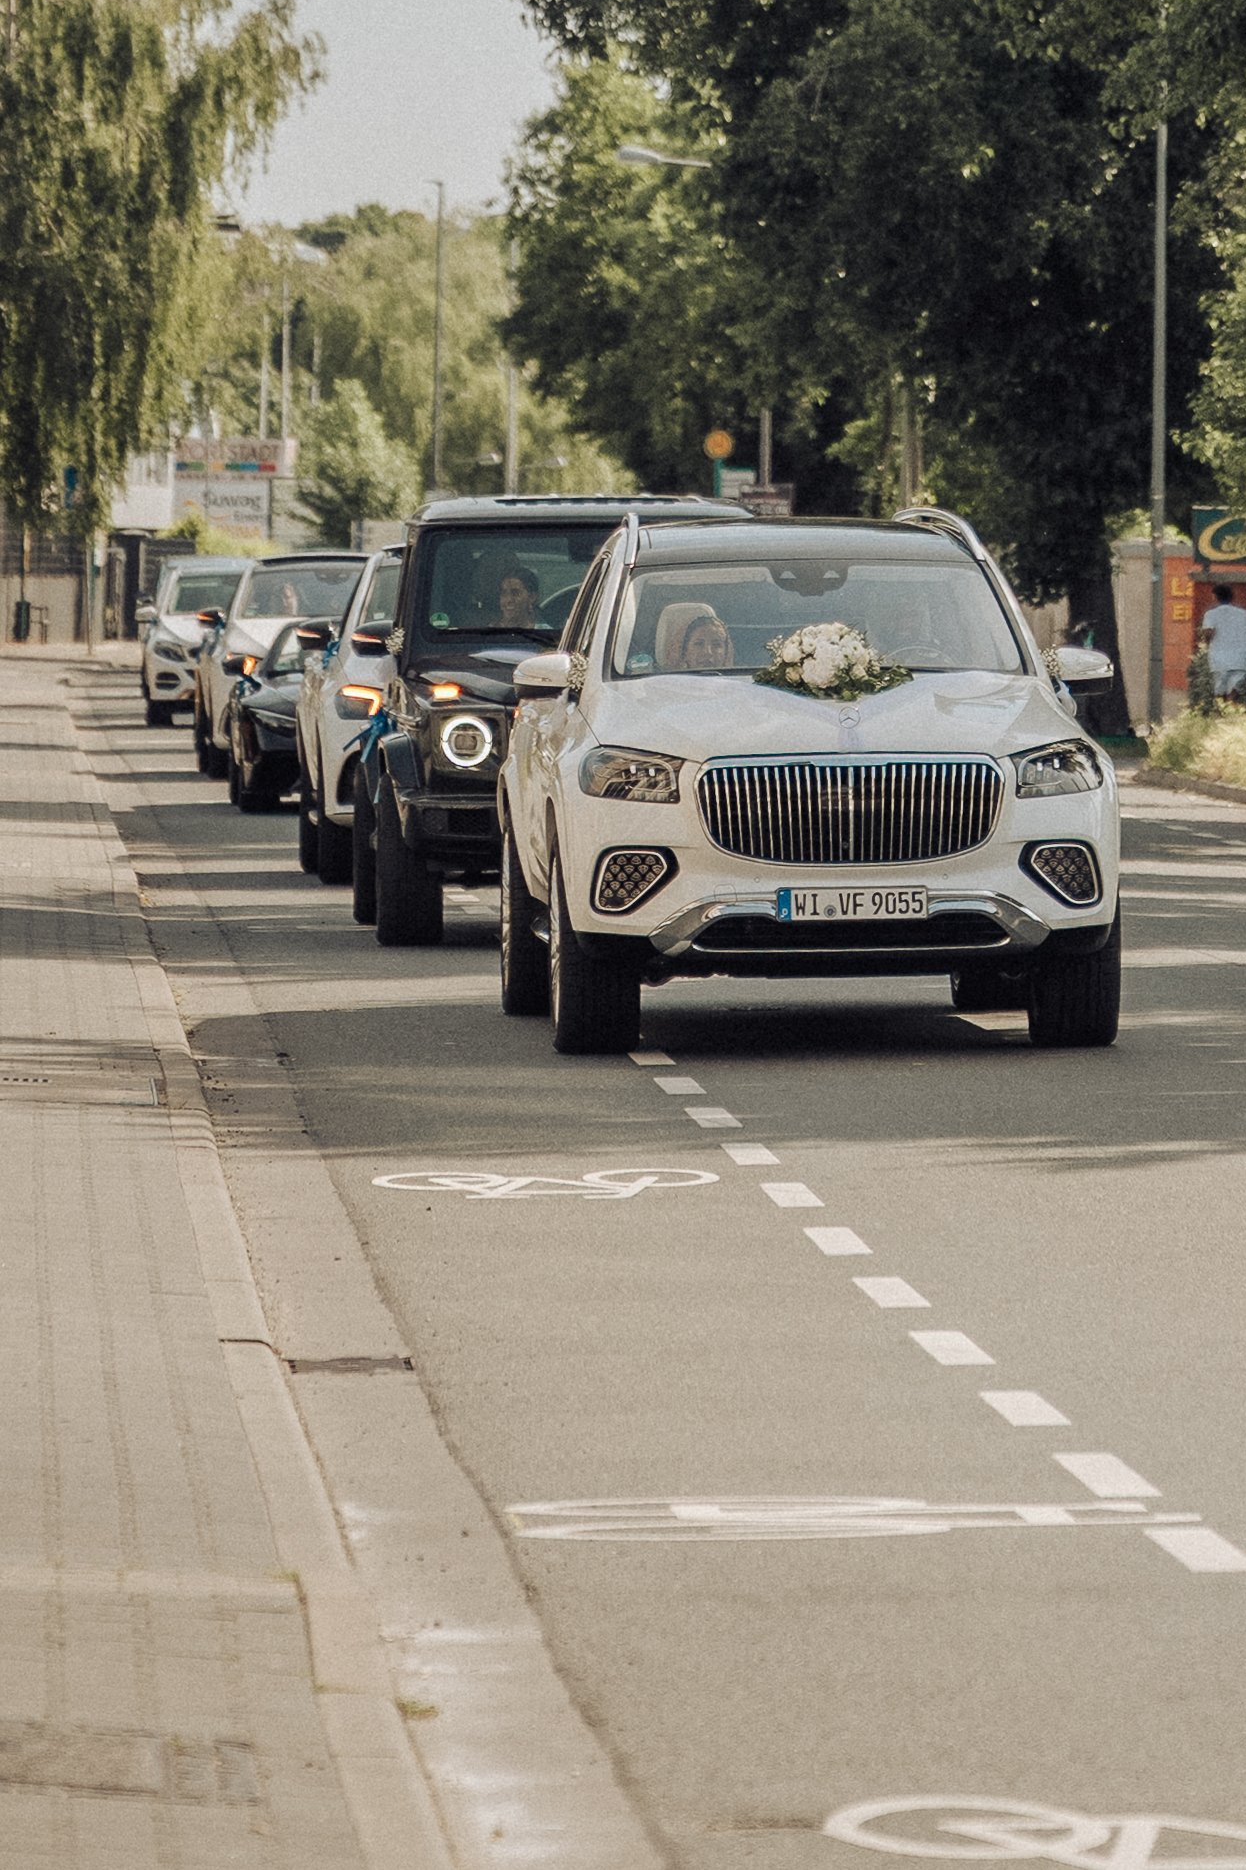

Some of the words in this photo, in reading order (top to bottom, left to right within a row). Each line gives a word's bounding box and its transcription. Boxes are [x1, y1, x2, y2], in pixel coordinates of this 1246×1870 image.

[795, 893, 820, 916] WI
[838, 892, 865, 916] VF
[871, 891, 924, 915] 9055
